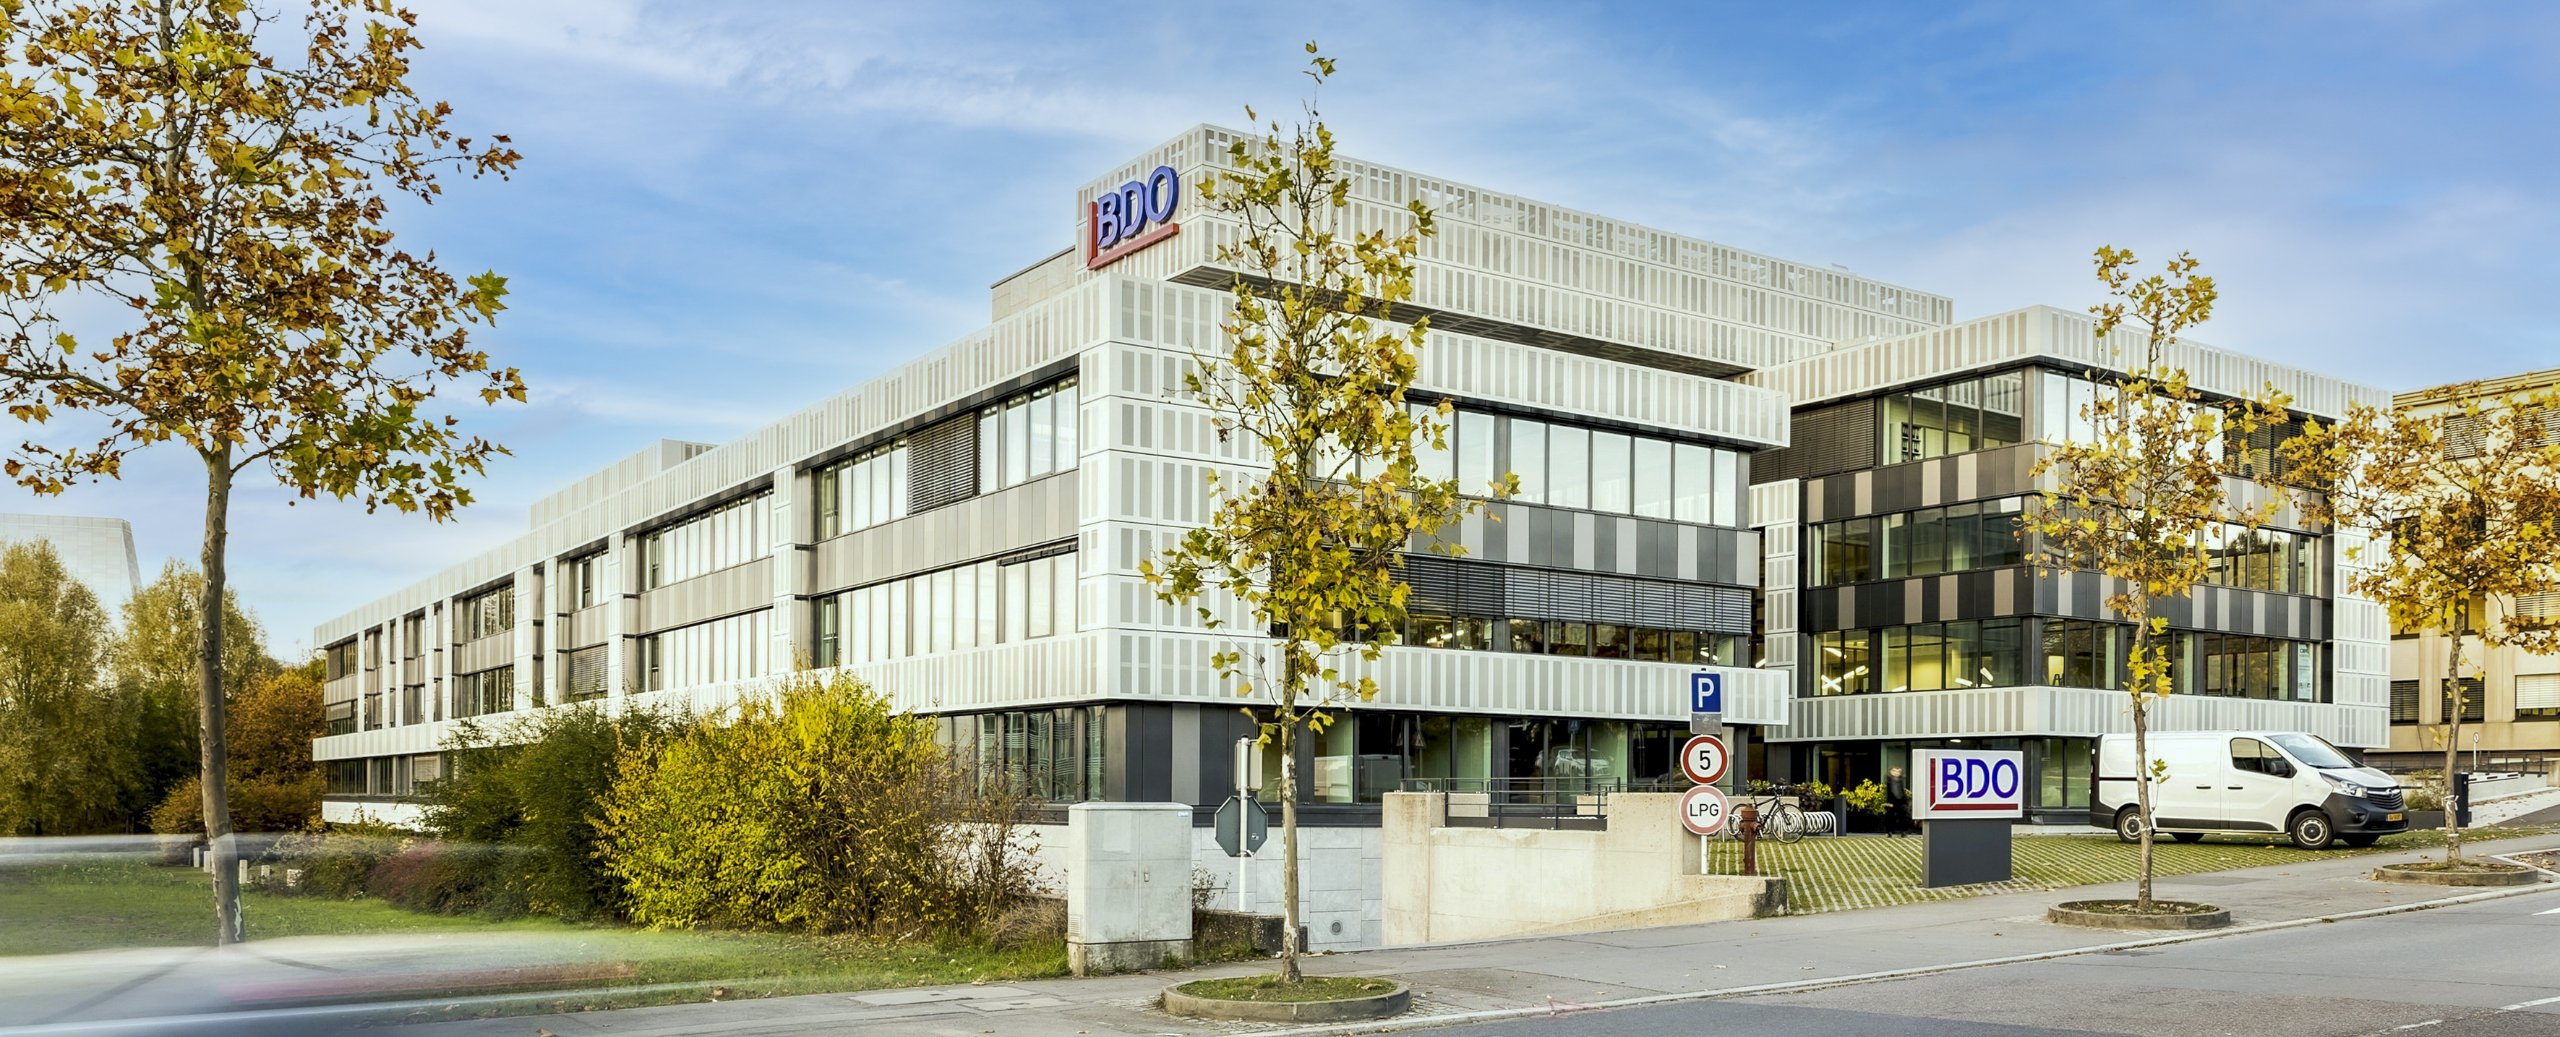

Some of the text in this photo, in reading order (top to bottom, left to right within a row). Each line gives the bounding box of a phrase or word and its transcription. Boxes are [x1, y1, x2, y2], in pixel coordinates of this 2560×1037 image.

[1097, 164, 1180, 249] BDO
[1697, 677, 1715, 708] P
[1699, 750, 1711, 770] 5
[1941, 757, 2019, 799] BDO
[1689, 803, 1720, 817] LPG
